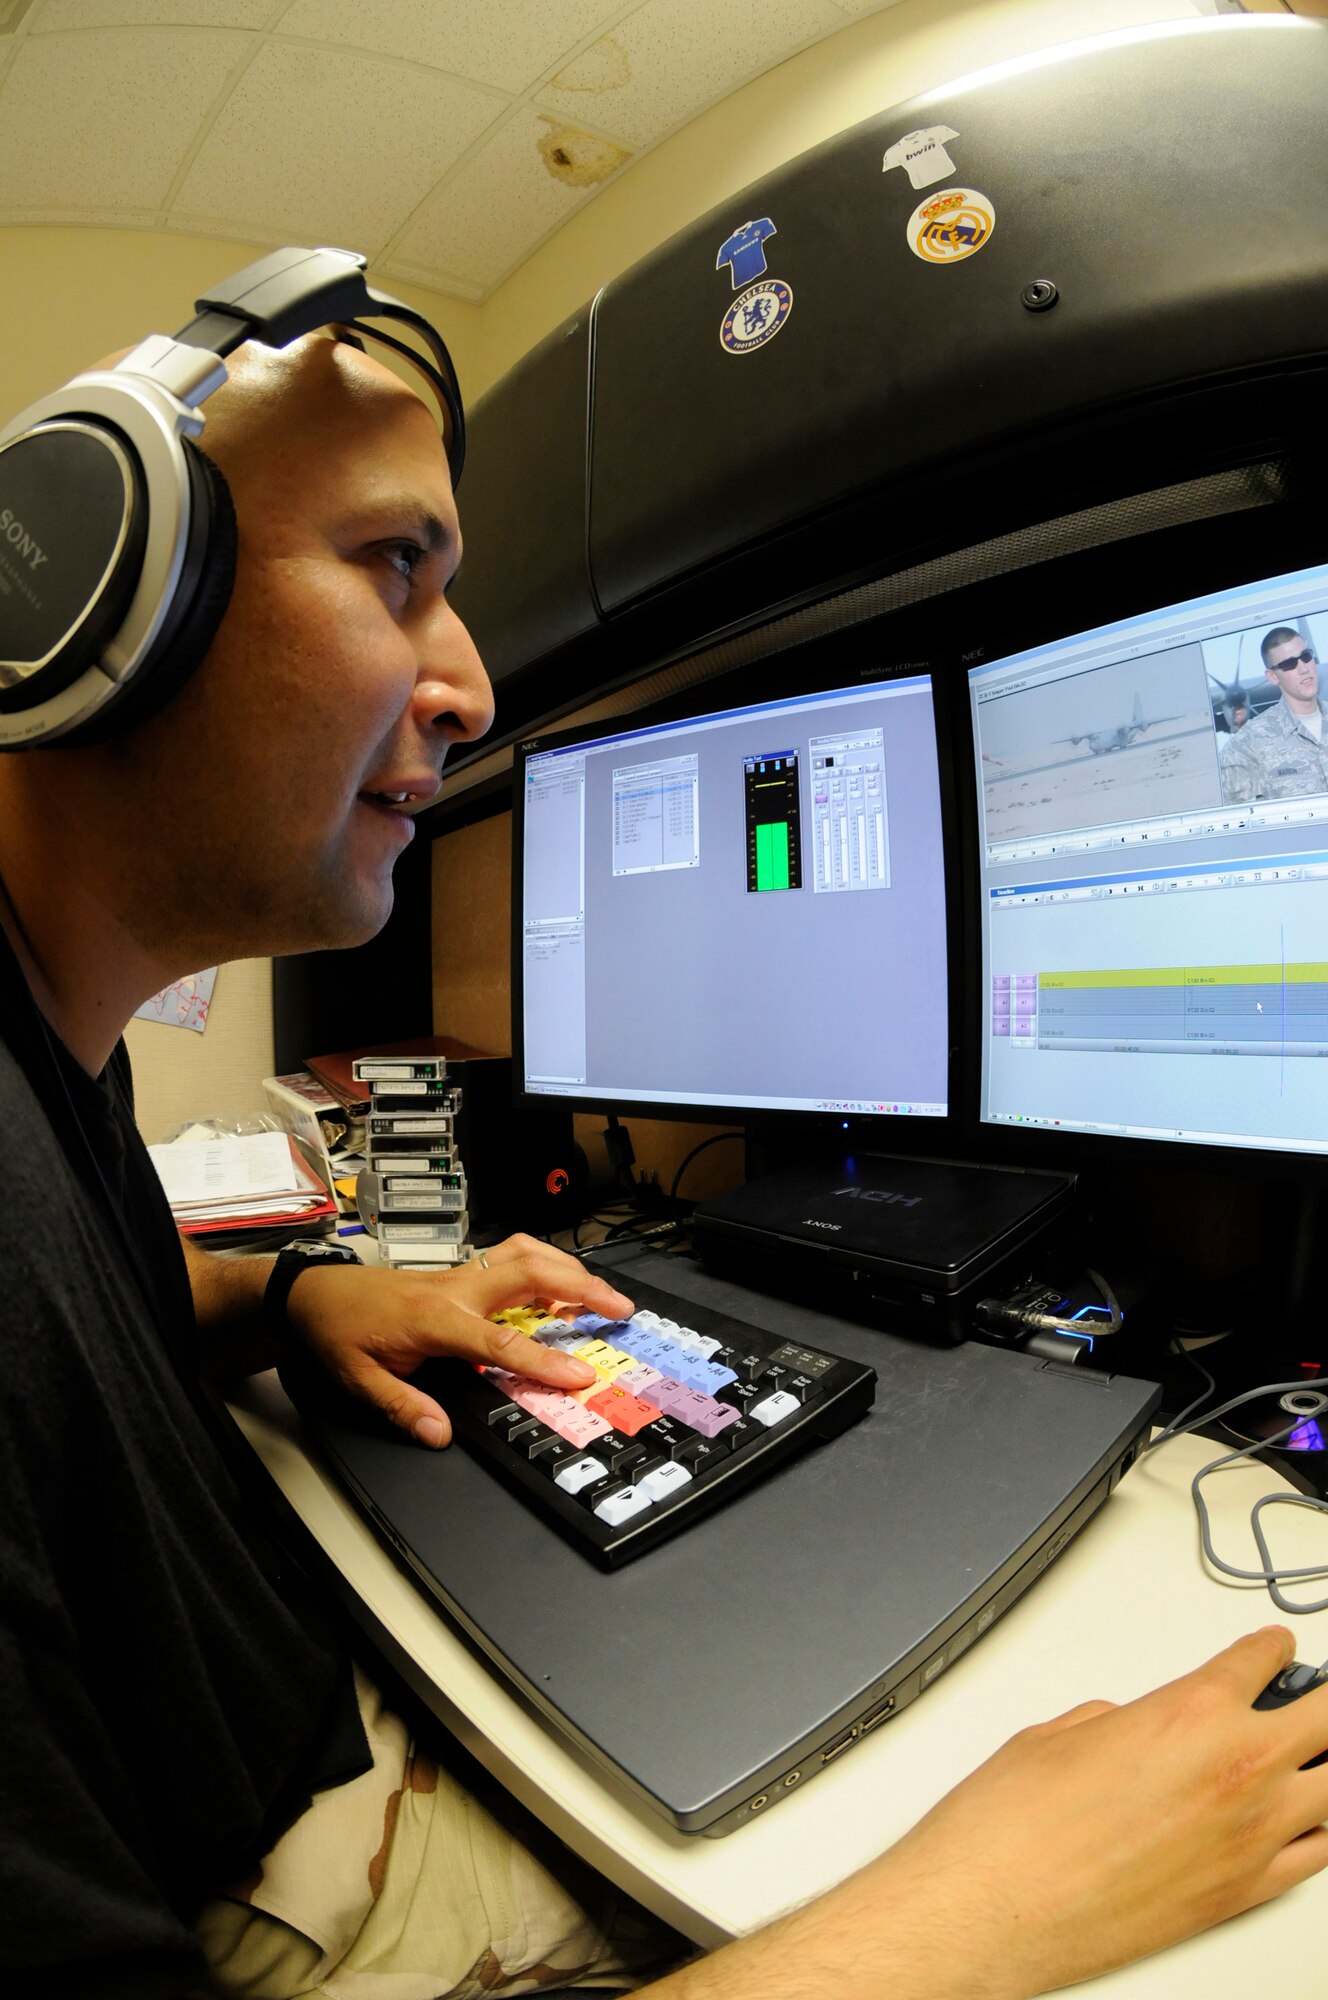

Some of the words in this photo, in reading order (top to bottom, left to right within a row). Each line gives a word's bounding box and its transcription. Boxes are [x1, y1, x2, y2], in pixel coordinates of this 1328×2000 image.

[905, 143, 936, 161] bwin
[733, 237, 759, 256] SAMSUNG
[733, 283, 777, 312] CHELSEA
[733, 336, 763, 349] FOOTBALL
[765, 320, 780, 337] CLUB
[0, 508, 48, 571] SONY
[961, 647, 985, 661] NEC
[521, 741, 539, 751] NEC
[802, 1219, 842, 1231] SONY
[738, 1388, 754, 1397] Space
[745, 1384, 759, 1392] Back
[611, 1441, 624, 1450] Shift
